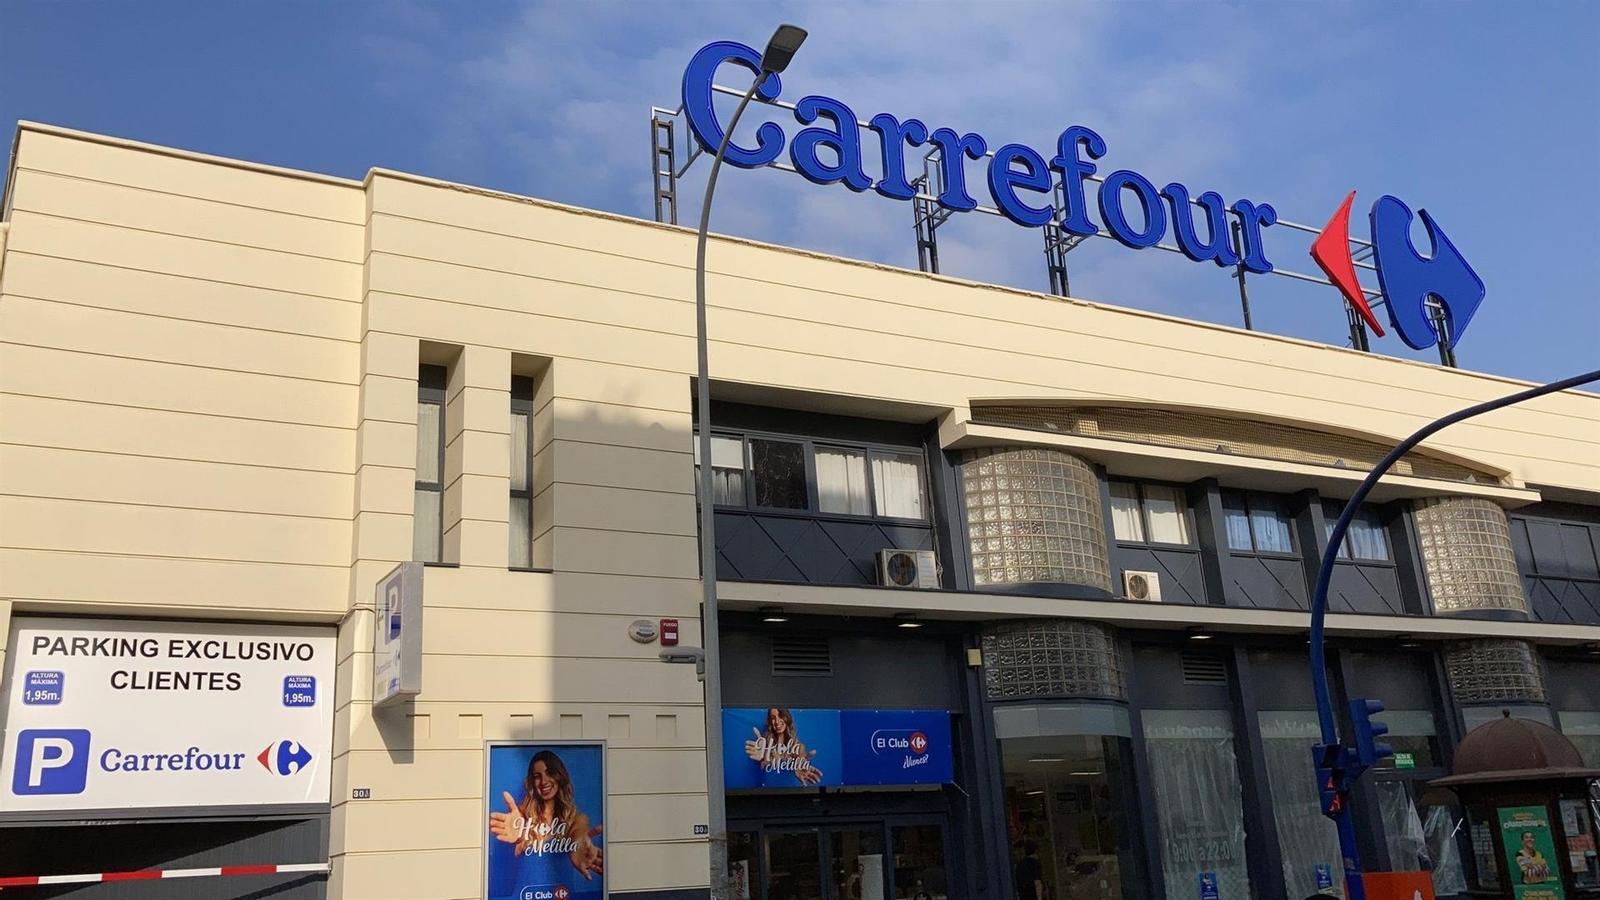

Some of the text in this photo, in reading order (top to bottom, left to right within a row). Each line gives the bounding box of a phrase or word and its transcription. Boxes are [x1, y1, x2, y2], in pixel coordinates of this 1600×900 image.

[681, 40, 1277, 273] Carrefour
[31, 635, 315, 661] PARKING EXCLUSIVO
[110, 670, 242, 691] CLIENTES
[25, 690, 61, 702] 1,95m.
[284, 693, 314, 704] 1,95m.
[876, 737, 909, 748] El Club
[27, 737, 246, 787] P Carrefour
[765, 754, 810, 774] Melilla
[902, 753, 929, 769] ¿Vienes?
[524, 837, 579, 857] Melilla
[525, 891, 553, 900] El Club
